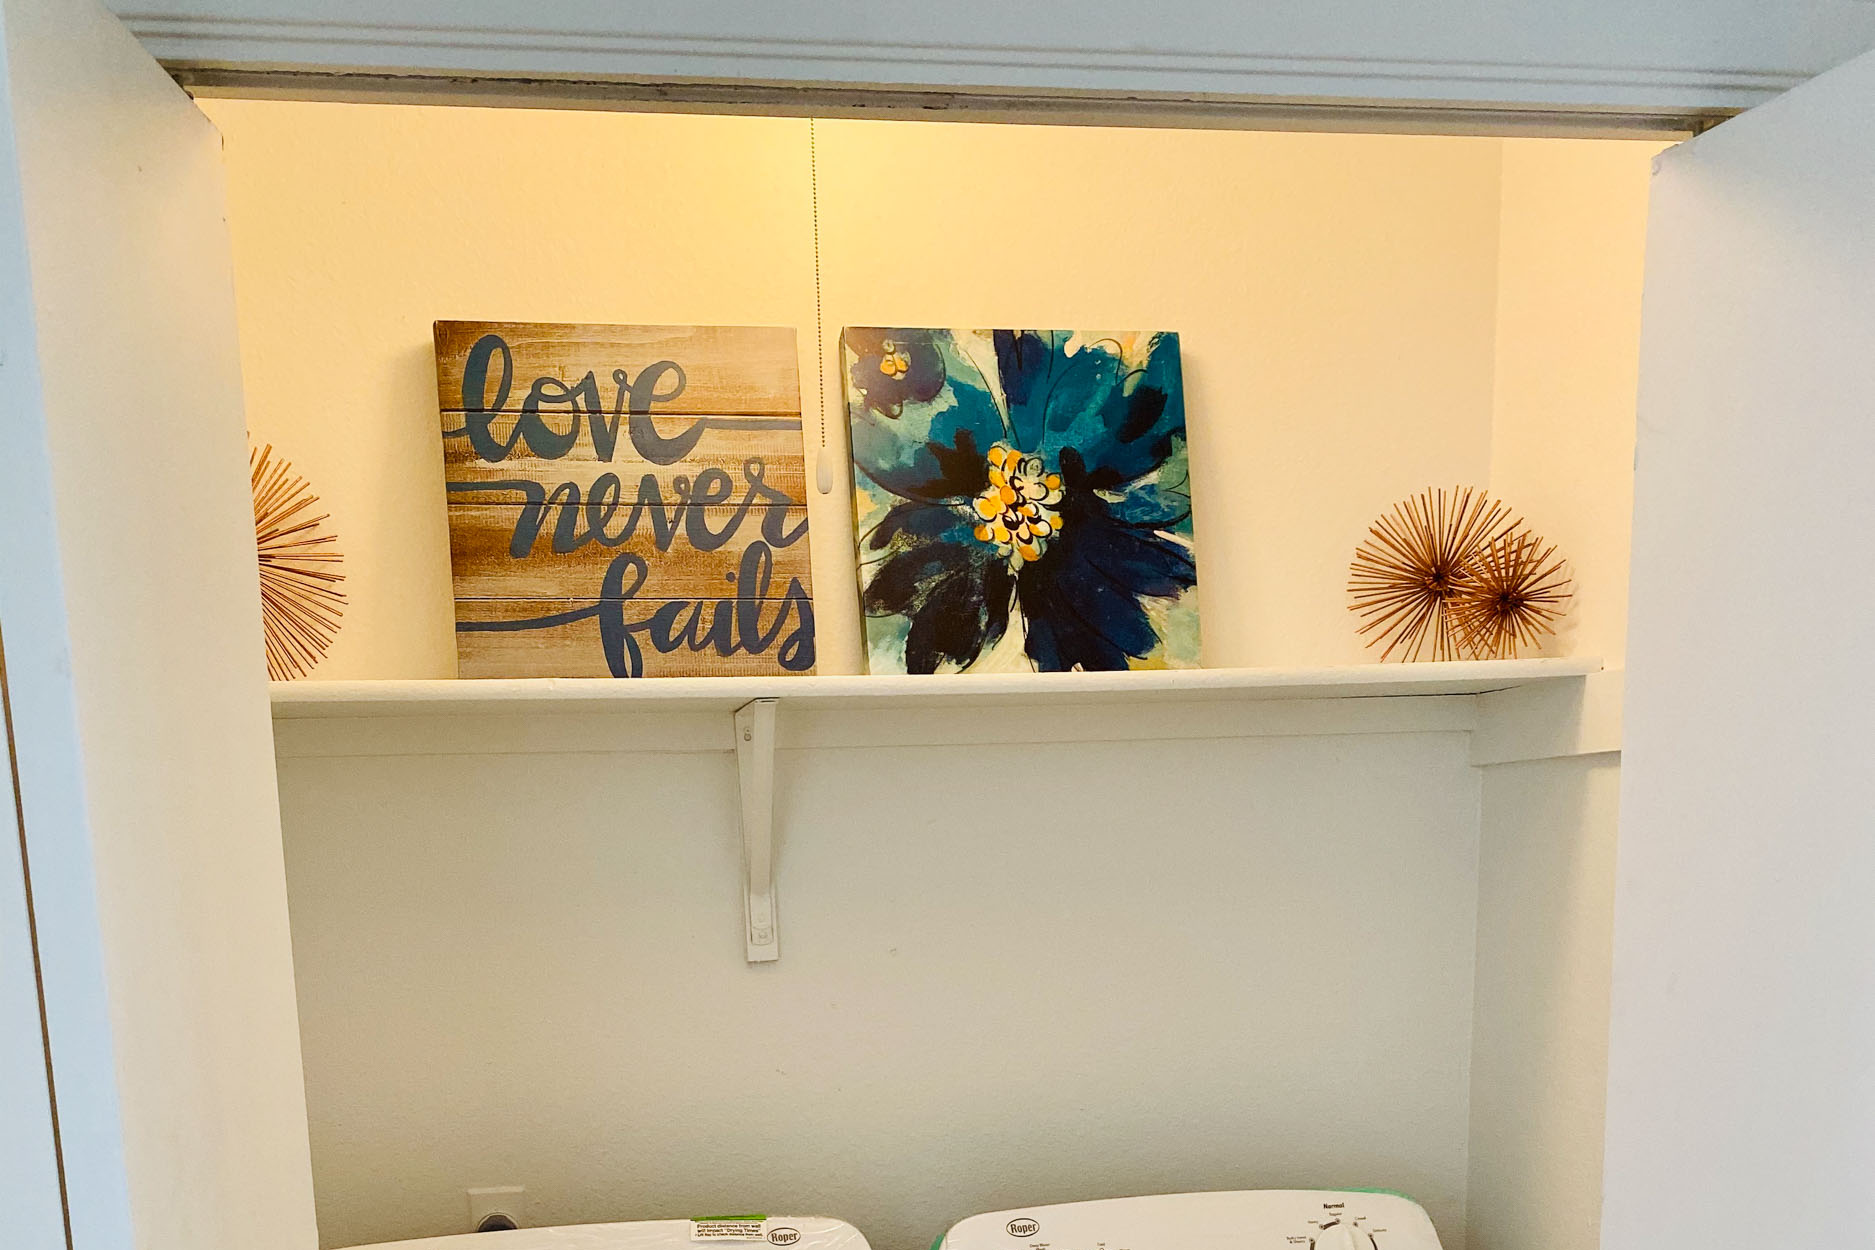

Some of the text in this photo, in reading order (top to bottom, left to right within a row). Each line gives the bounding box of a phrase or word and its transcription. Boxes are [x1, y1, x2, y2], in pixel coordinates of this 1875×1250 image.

[442, 335, 802, 465] love
[446, 457, 808, 558] never
[456, 541, 816, 678] fails
[770, 1231, 798, 1243] Roper
[1010, 1222, 1037, 1235] Roper
